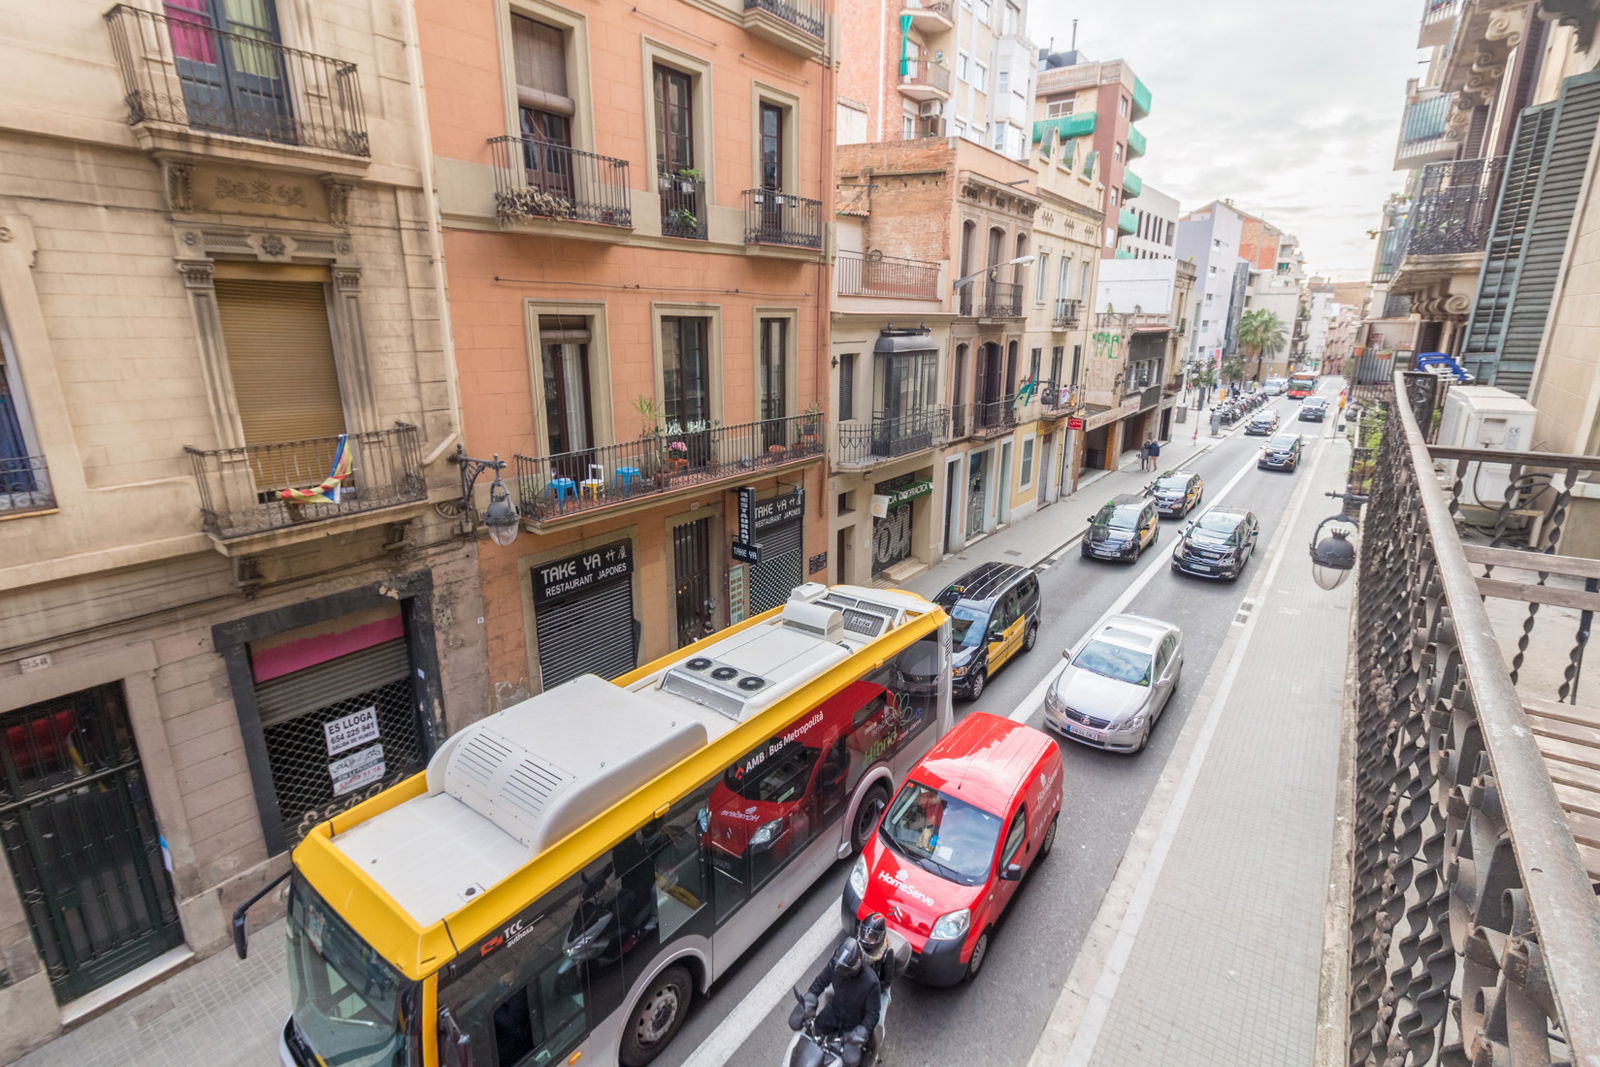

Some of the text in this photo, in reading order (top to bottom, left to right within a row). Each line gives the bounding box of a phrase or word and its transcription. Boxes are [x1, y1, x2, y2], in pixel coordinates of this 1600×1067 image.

[740, 491, 749, 544] RESTAURANT
[755, 499, 787, 519] TAKE YA
[755, 513, 781, 528] RESTAURANT
[733, 546, 757, 560] TAKE YA
[540, 553, 601, 585] TAKE YA
[545, 573, 593, 597] RESTAURANT
[328, 711, 373, 735] ES LLOGA
[346, 727, 360, 738] 225
[745, 710, 824, 773] AMB Bus Metropolità
[878, 870, 935, 907] HomeServe
[503, 919, 523, 940] TCC
[507, 925, 534, 949] authosa
